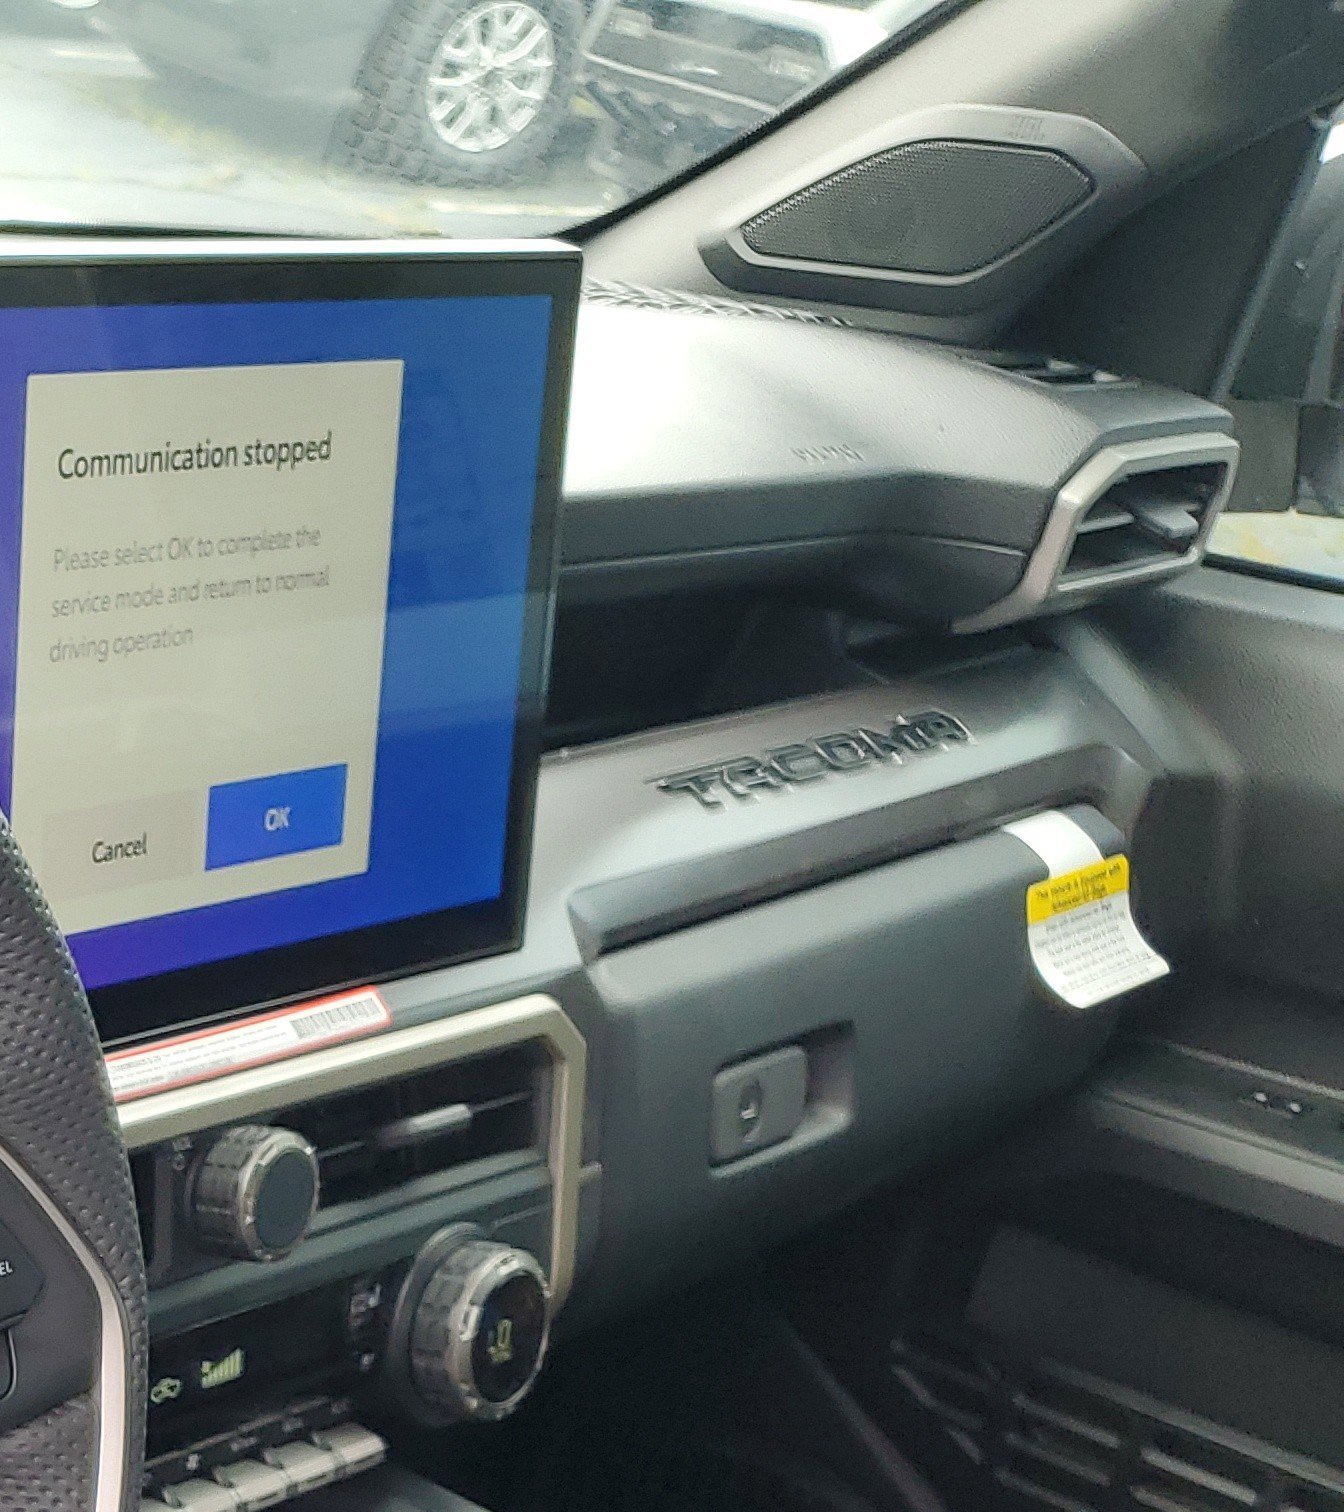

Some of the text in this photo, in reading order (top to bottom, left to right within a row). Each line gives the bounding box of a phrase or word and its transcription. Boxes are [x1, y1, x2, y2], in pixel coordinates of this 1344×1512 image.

[57, 430, 332, 479] Communication stopped
[52, 524, 322, 573] Please select OK to complete the
[51, 565, 331, 618] service mode and return to normal
[49, 624, 194, 663] driving operation
[647, 708, 979, 812] TACOMA
[265, 806, 291, 832] OK
[91, 831, 148, 864] Cancel
